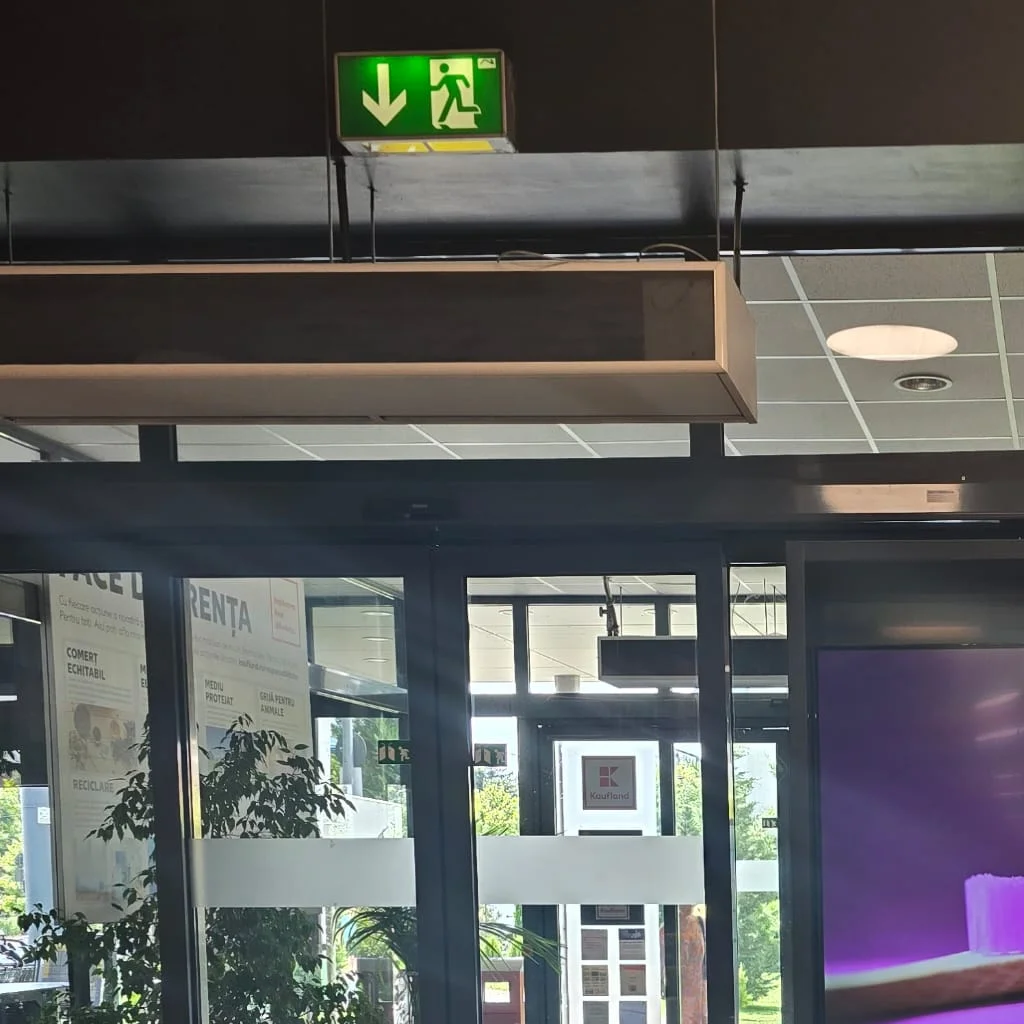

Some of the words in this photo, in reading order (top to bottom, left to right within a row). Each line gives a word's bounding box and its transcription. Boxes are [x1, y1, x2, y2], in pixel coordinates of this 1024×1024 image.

[67, 662, 106, 681] ECHITABIL
[205, 679, 224, 692] MEDIU
[206, 692, 234, 706] PROTEJAT
[73, 779, 115, 793] RECICLARE
[590, 791, 630, 800] Kaufland
